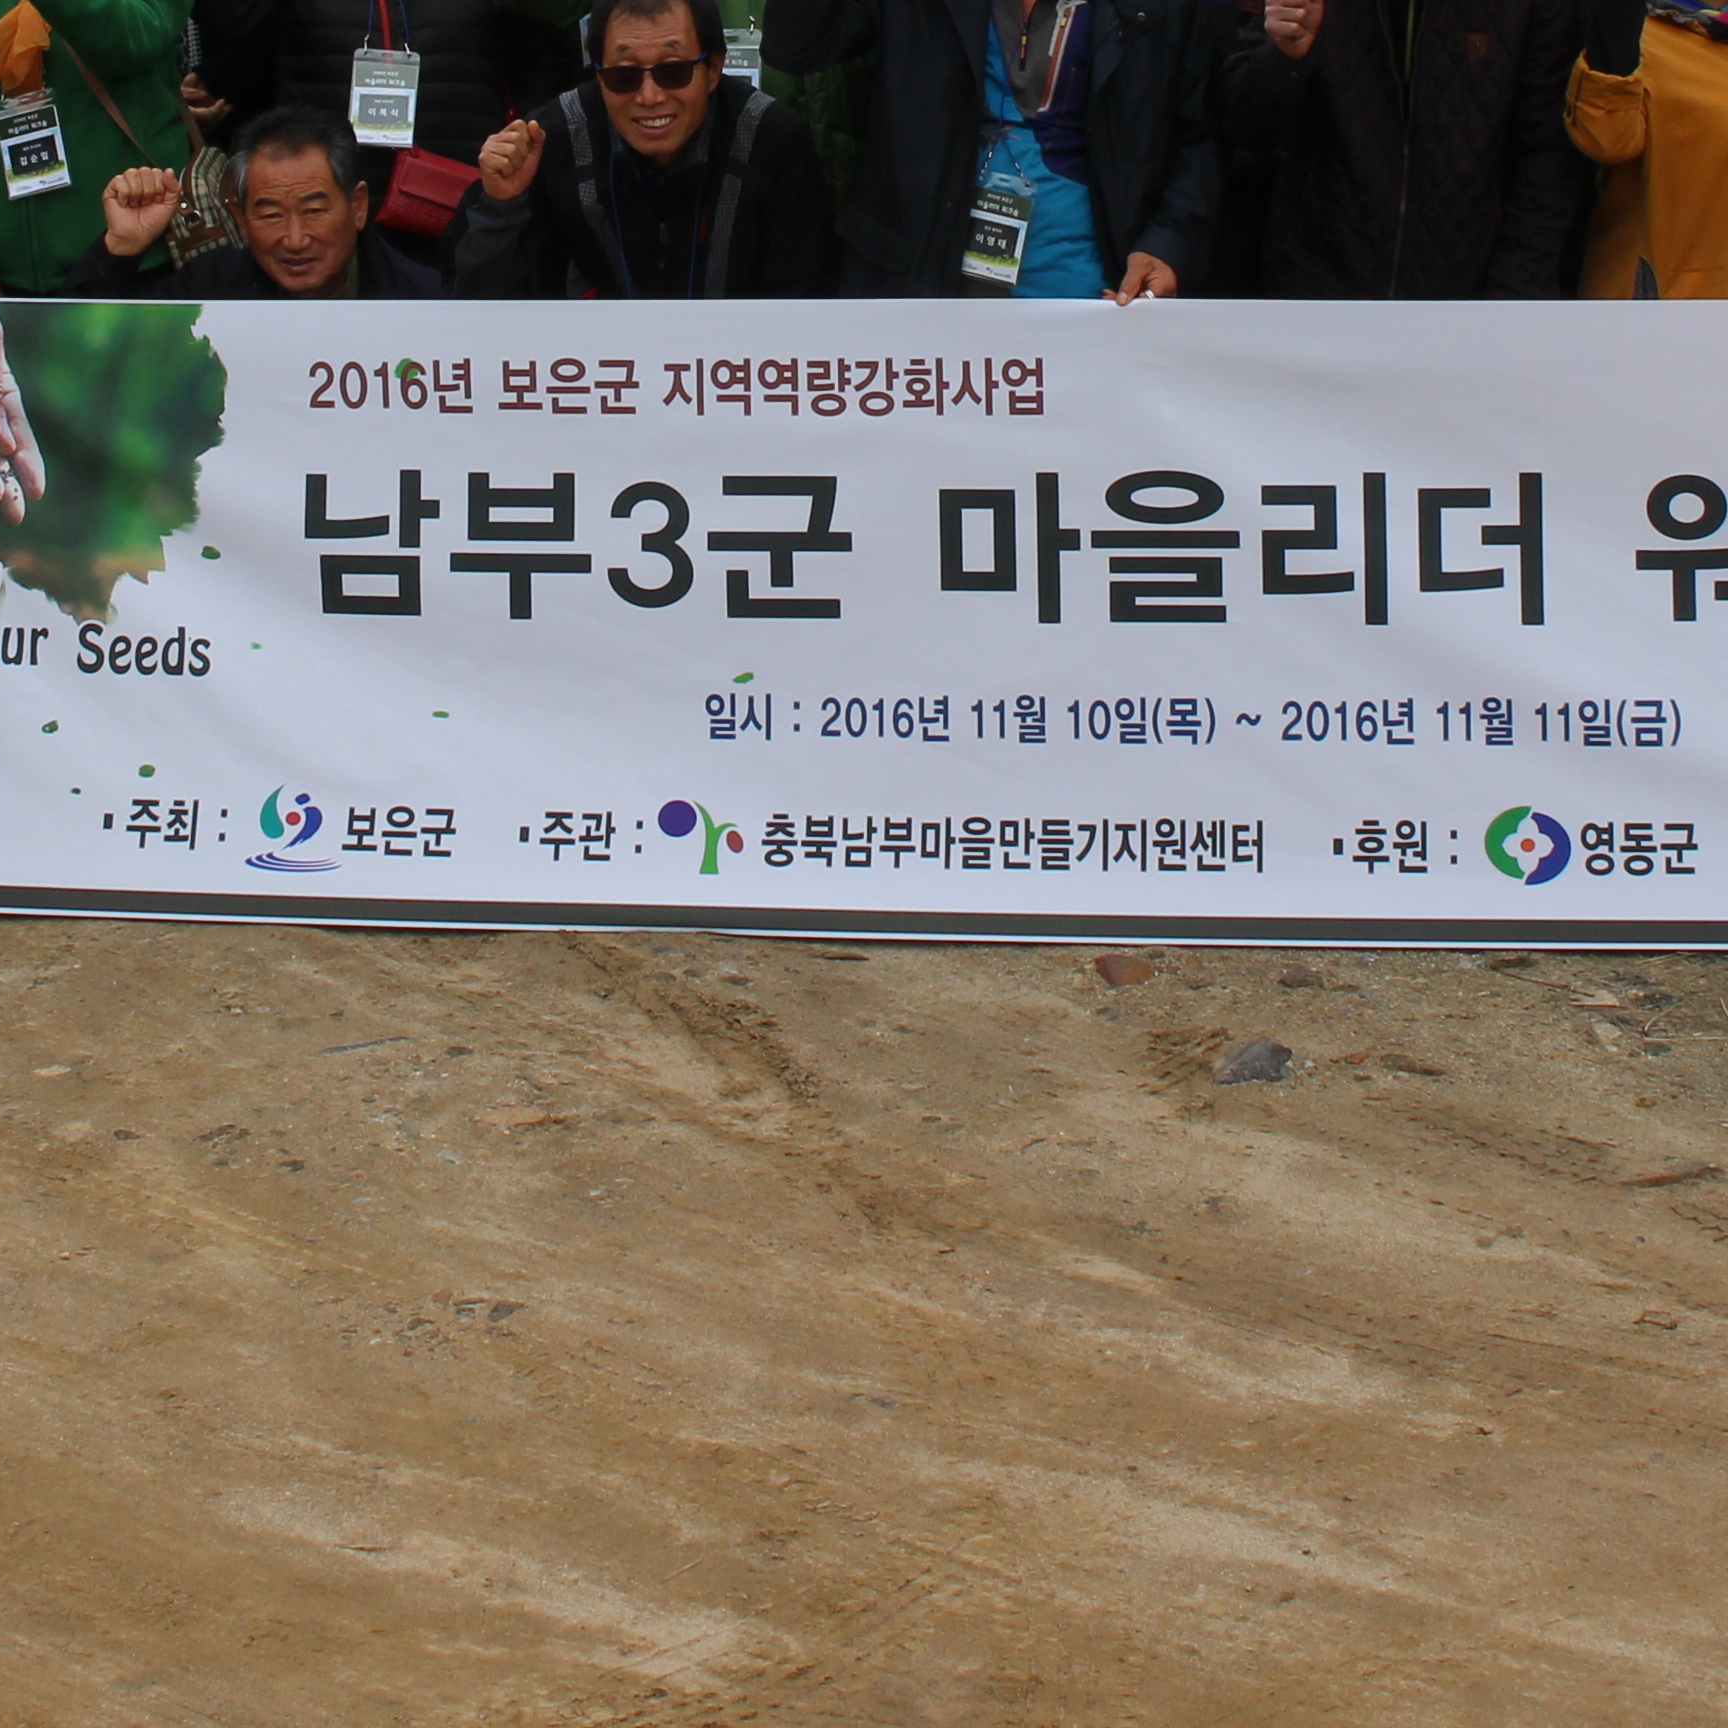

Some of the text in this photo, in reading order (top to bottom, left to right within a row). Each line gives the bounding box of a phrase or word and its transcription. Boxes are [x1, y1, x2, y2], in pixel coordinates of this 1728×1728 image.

[309, 357, 1044, 417] 2016년 보은군 지역역량강화사업
[304, 469, 853, 620] 남부3군
[938, 470, 1545, 626] 마을리더
[76, 620, 212, 678] Seeds
[705, 693, 773, 742] 일시
[820, 695, 950, 743] 2016년
[970, 694, 1047, 744] 11월
[1067, 696, 1216, 746] 10일(목)
[1281, 697, 1415, 746] 2016년
[1436, 696, 1514, 746] 11월
[1534, 698, 1682, 748] 11일(금)
[125, 798, 199, 851] 주최
[341, 805, 457, 858] 보은군
[539, 811, 617, 862] 주관
[761, 813, 1264, 874] 충북남부마을만들기지원센터
[1352, 819, 1429, 875] 후원
[1580, 821, 1699, 877] 영동군
